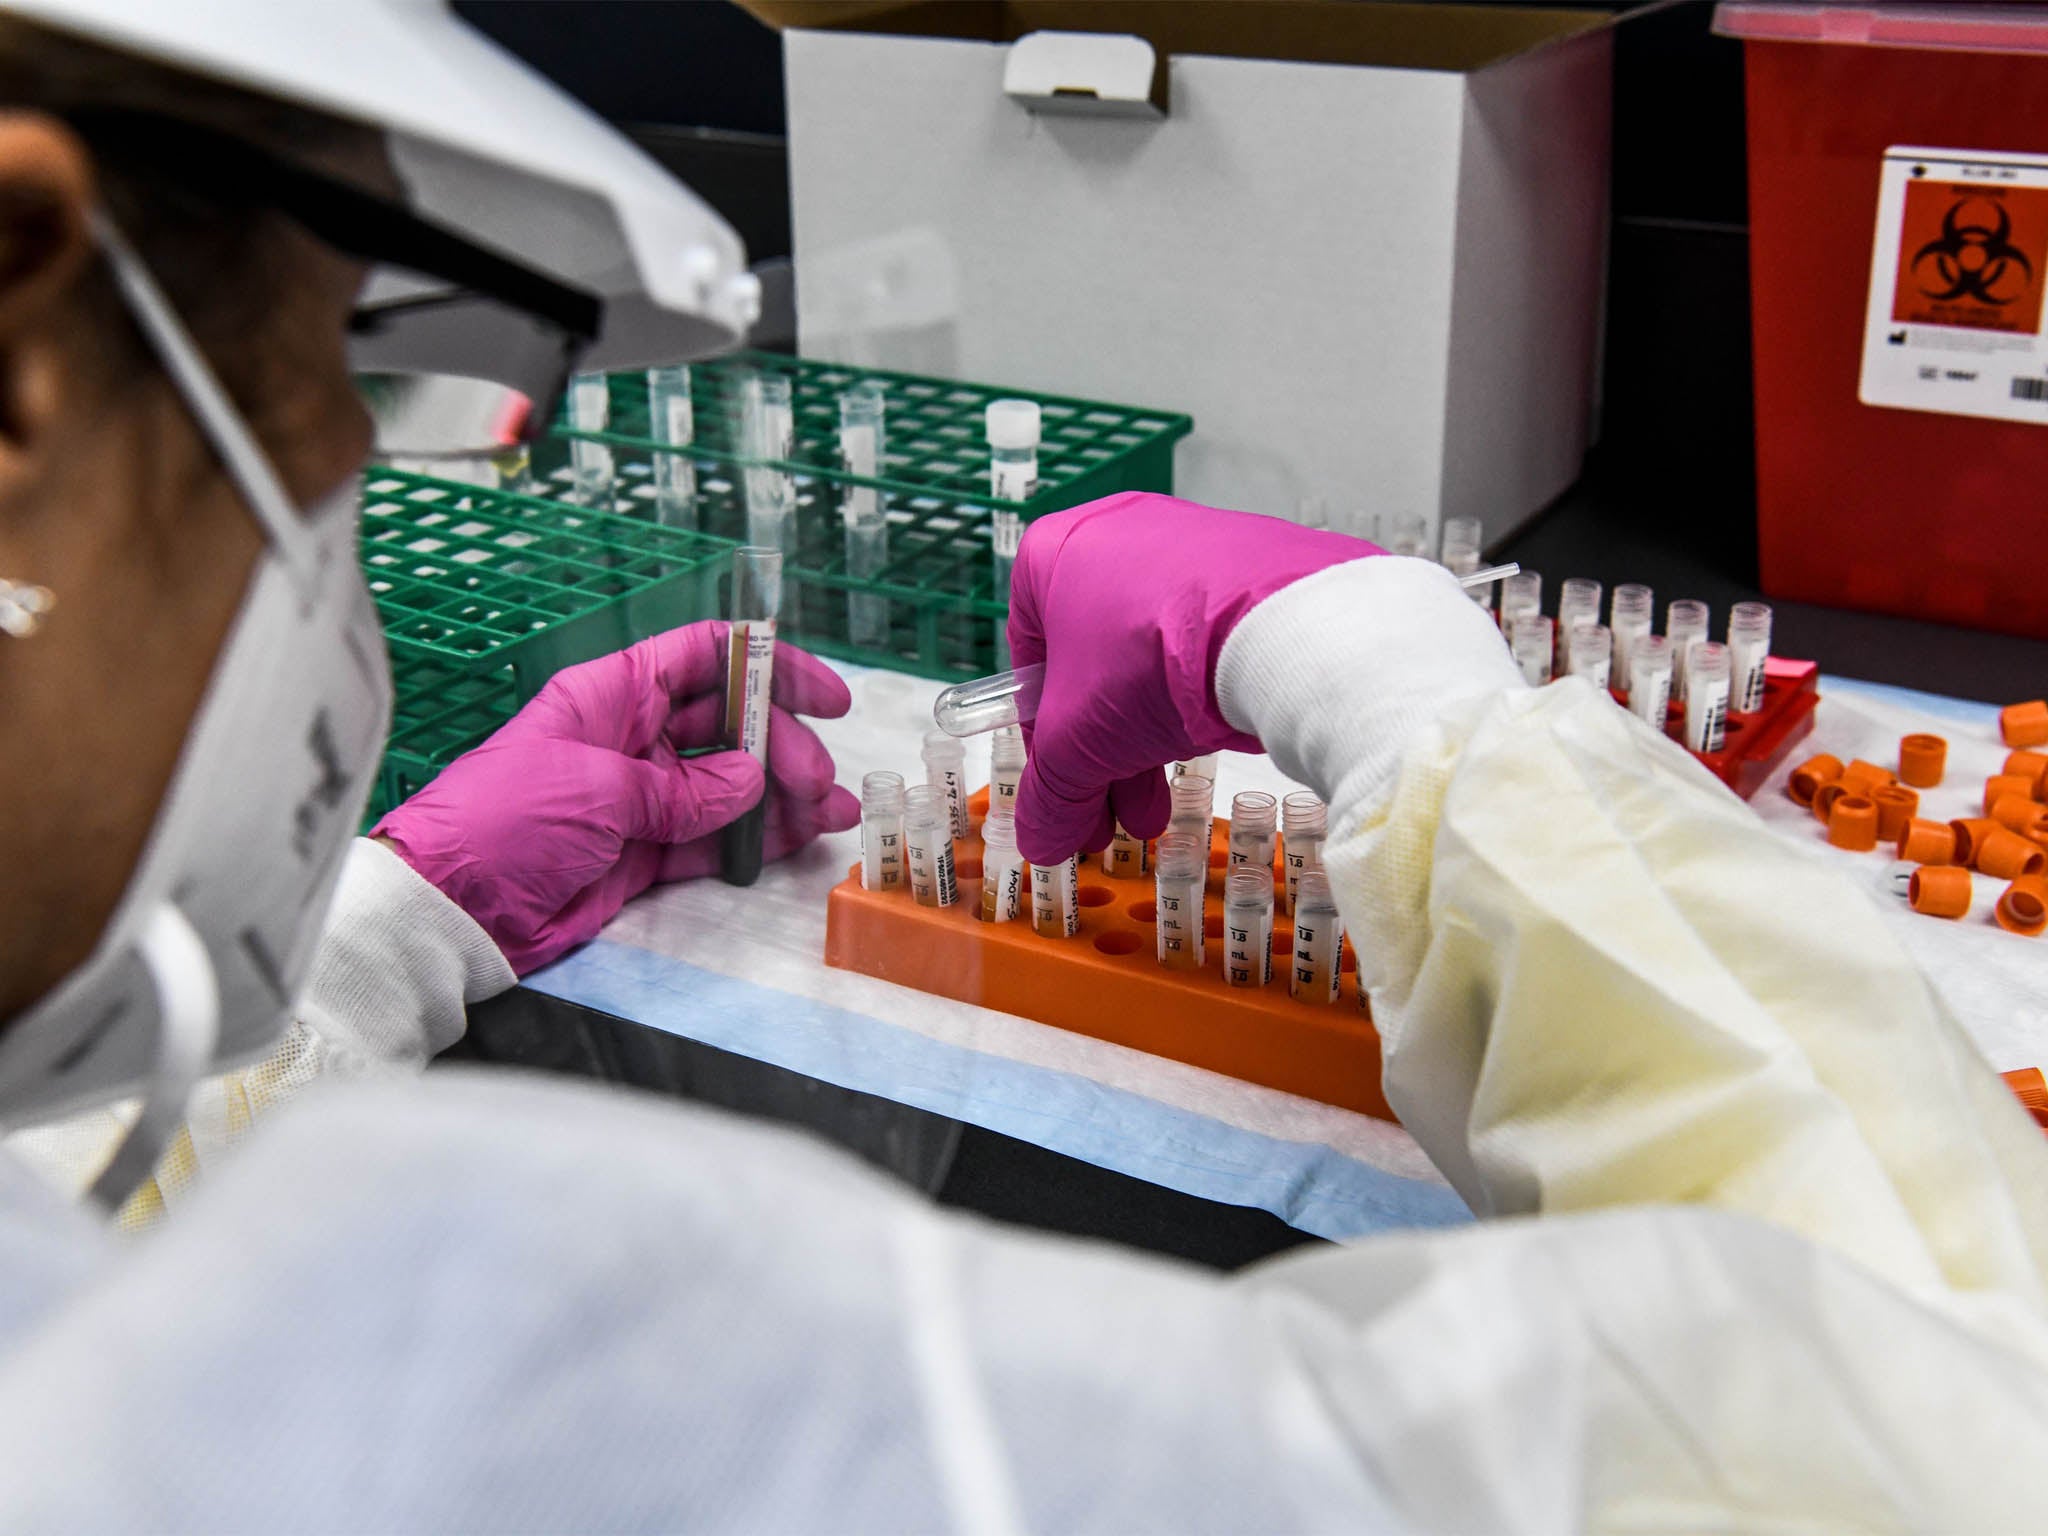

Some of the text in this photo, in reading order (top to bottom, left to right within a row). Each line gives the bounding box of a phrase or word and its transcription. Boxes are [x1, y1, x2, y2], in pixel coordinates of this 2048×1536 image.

[999, 786, 1014, 797] 1.8
[1289, 857, 1304, 868] 1.8
[1035, 872, 1049, 883] 1.8
[1163, 900, 1178, 911] 1.8
[1163, 919, 1182, 930] mL
[1231, 931, 1247, 942] 1.8
[1231, 951, 1249, 961] mL
